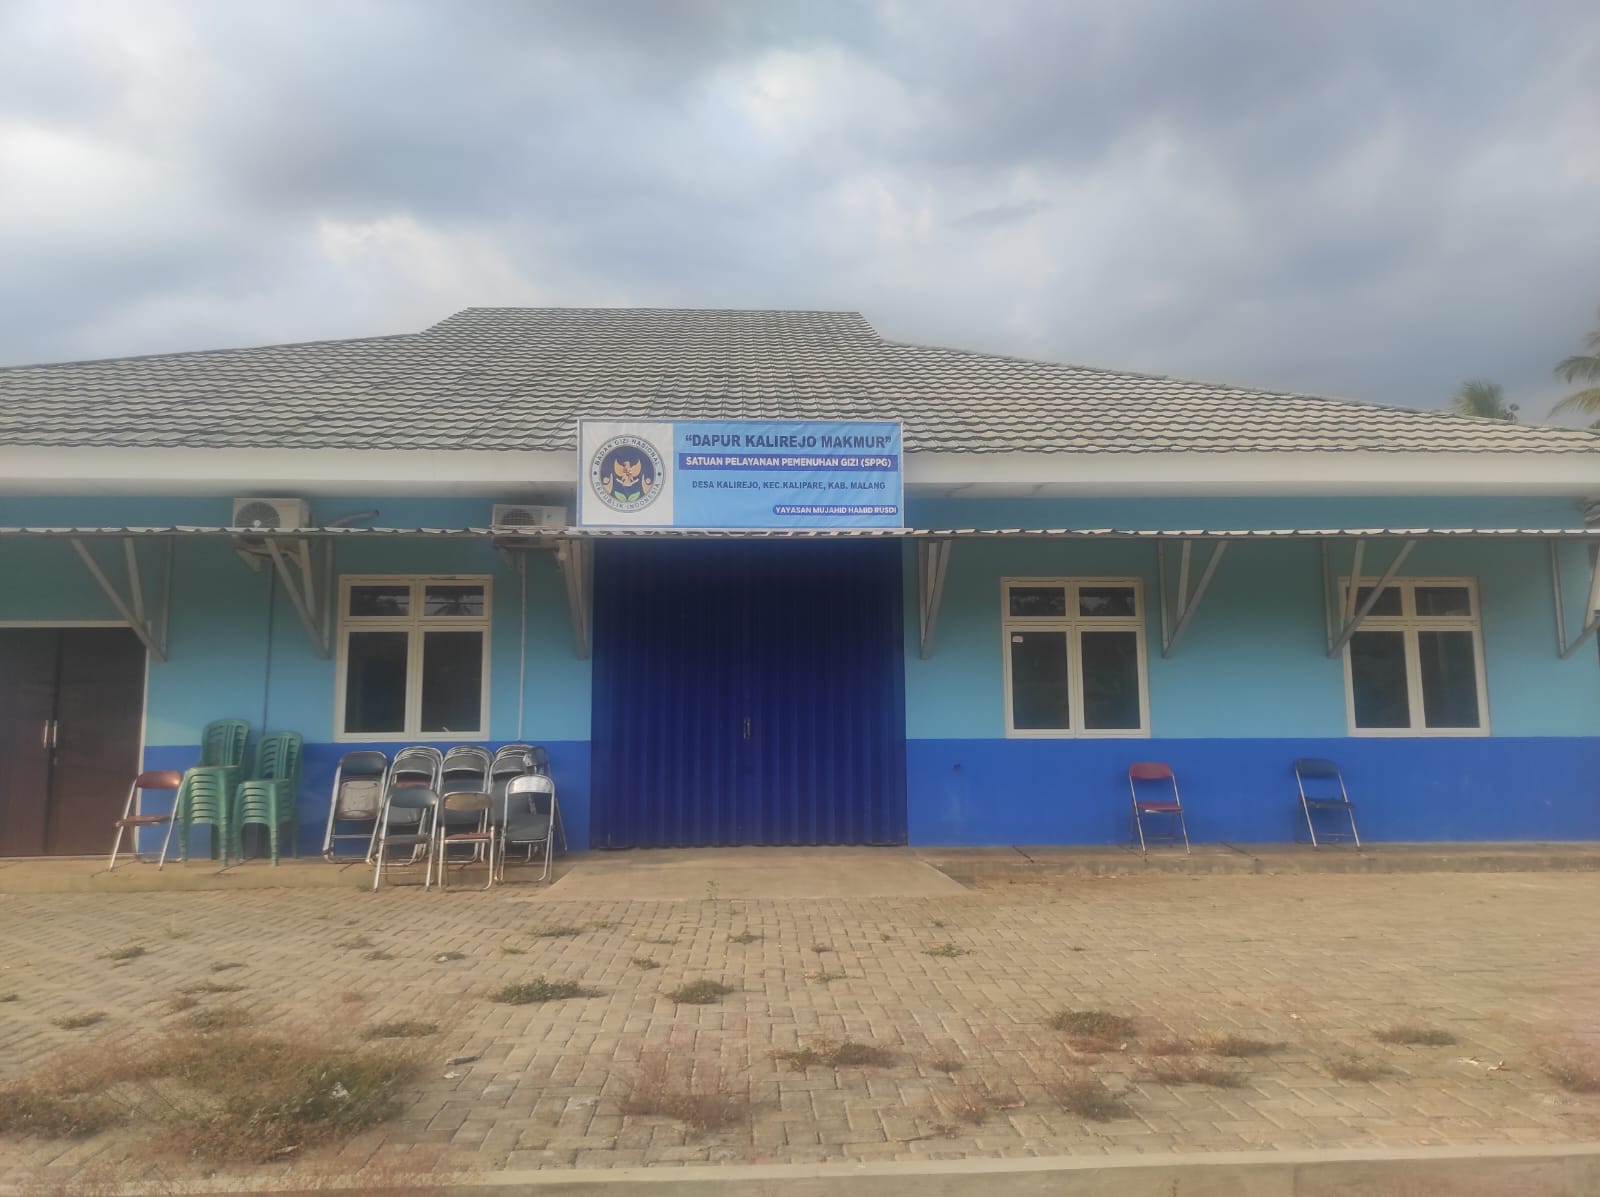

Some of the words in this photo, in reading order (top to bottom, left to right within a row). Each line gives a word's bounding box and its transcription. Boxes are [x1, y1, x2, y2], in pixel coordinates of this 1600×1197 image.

[745, 434, 817, 448] KALIREJO
[594, 444, 613, 466] BADAN
[614, 438, 629, 446] GIZI
[631, 439, 661, 466] NASIONAL
[686, 456, 723, 466] SATUAN
[725, 457, 780, 466] PELAYANAN
[781, 457, 839, 467] PEMENUHAN
[840, 458, 859, 467] GIZI
[861, 458, 892, 468] (SPPG)
[692, 480, 715, 489] DESA
[716, 480, 761, 490] KALIREJO,
[828, 481, 848, 490] KAB.
[850, 481, 886, 490] MALANG
[594, 481, 625, 509] REPUBLIK
[626, 482, 661, 510] INDONESIA
[775, 506, 812, 514] YAYASAN
[812, 506, 847, 514] MUJAHID
[848, 506, 873, 514] HAMID
[874, 506, 897, 514] RUSDI
